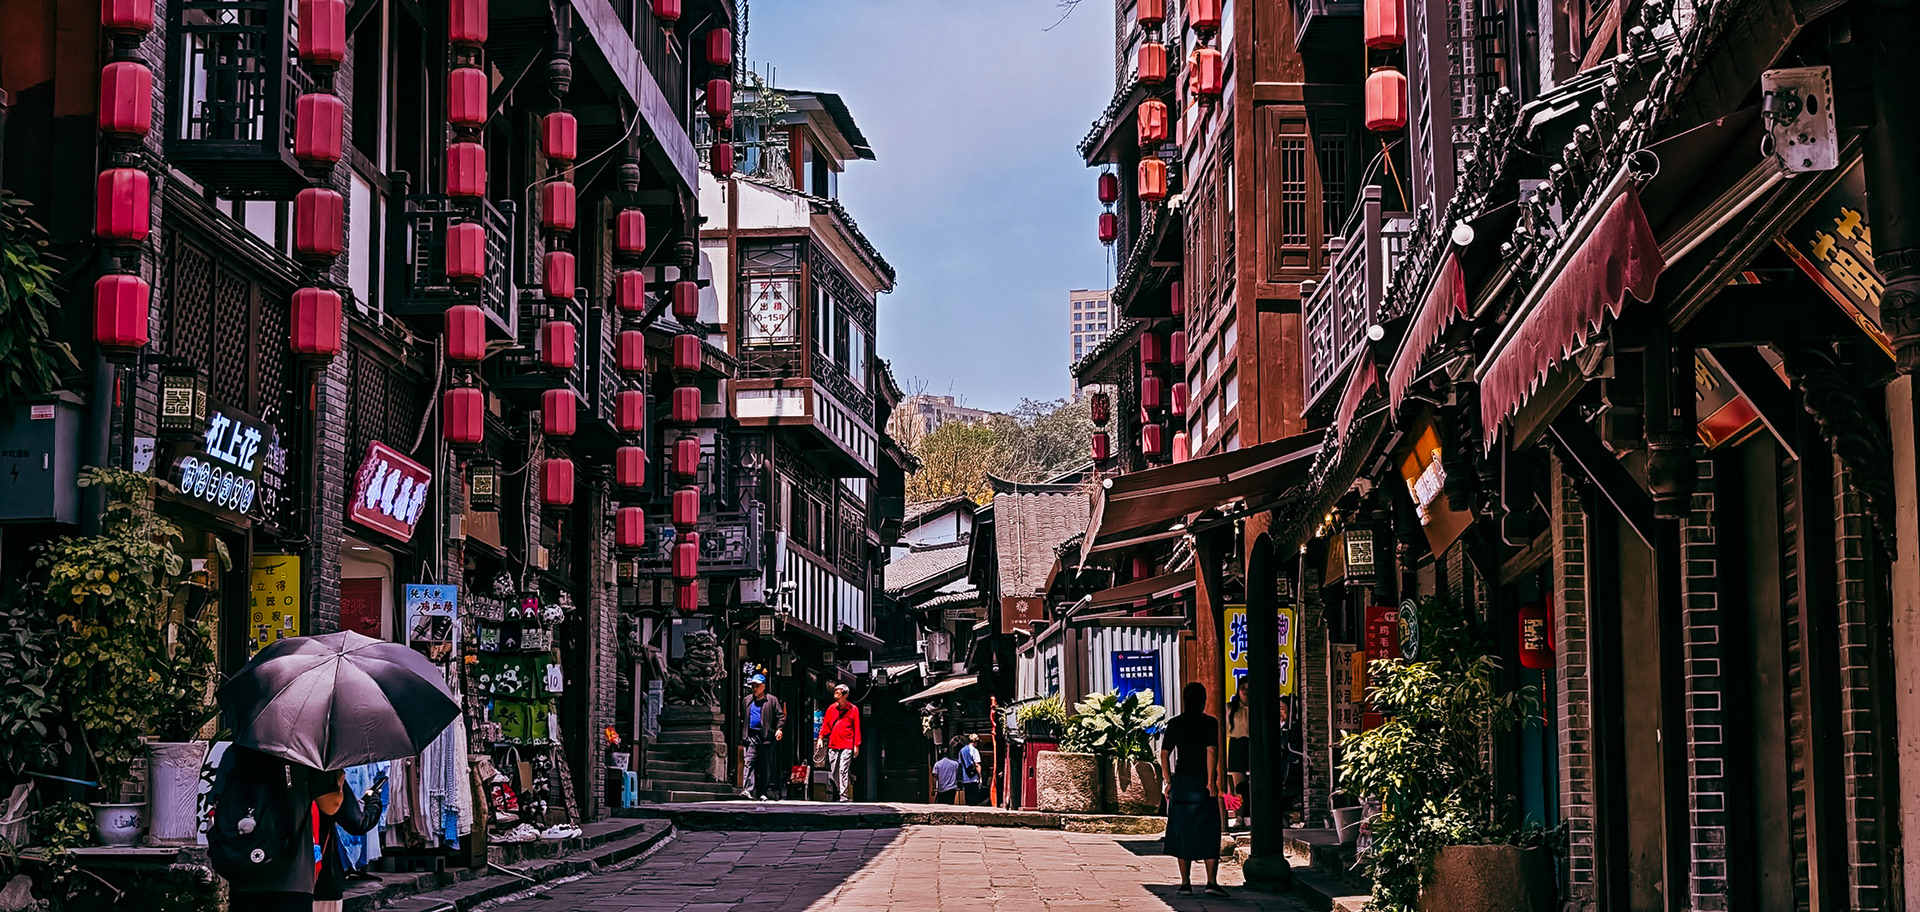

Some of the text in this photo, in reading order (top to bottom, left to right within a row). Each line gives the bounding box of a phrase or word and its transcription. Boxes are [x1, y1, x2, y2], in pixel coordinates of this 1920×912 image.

[206, 411, 262, 471] 杠上花
[1336, 650, 1352, 666] 八字
[550, 676, 558, 688] 10
[1336, 689, 1351, 705] 公司
